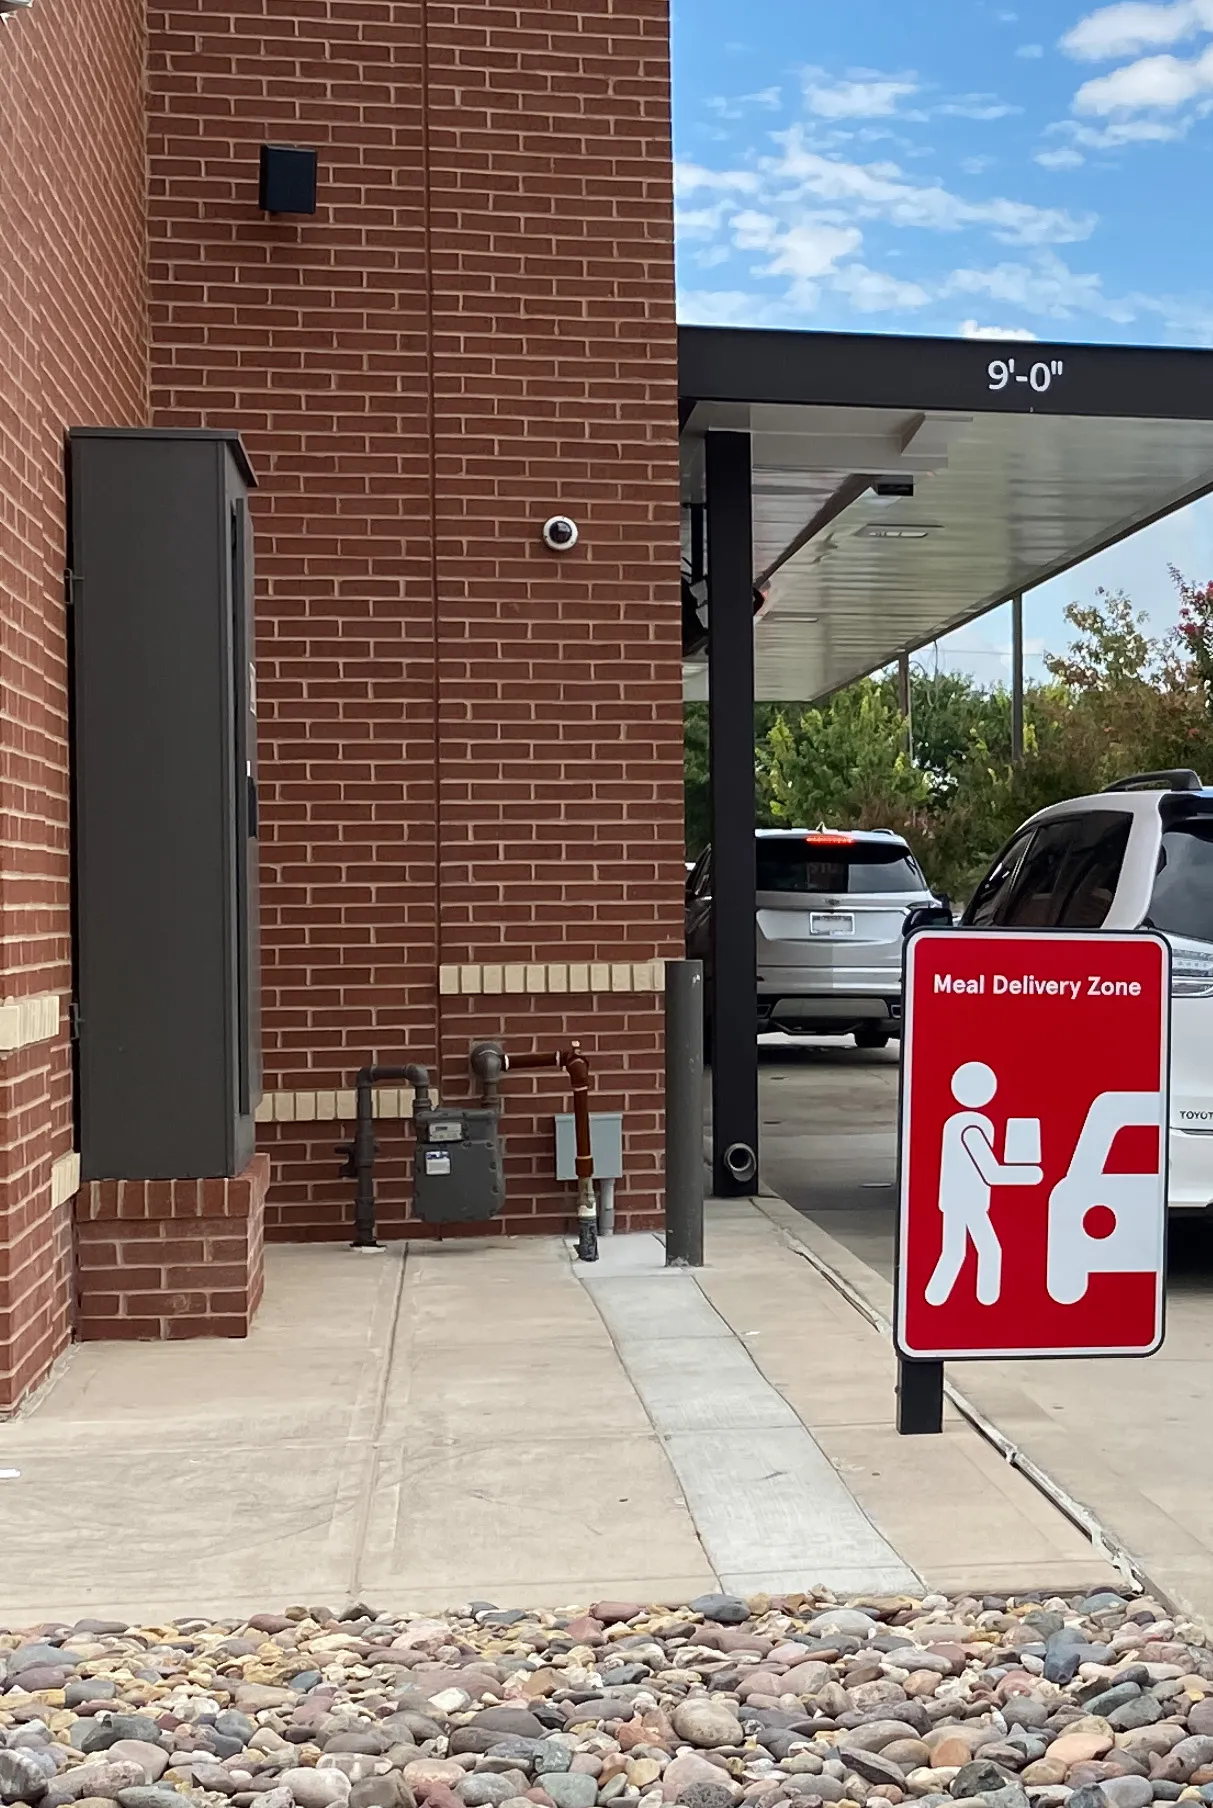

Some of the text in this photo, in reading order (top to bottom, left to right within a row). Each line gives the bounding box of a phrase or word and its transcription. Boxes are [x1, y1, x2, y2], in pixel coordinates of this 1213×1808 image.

[987, 358, 1064, 393] 9'-0"
[933, 973, 1142, 1000] Meal Delivery Zone
